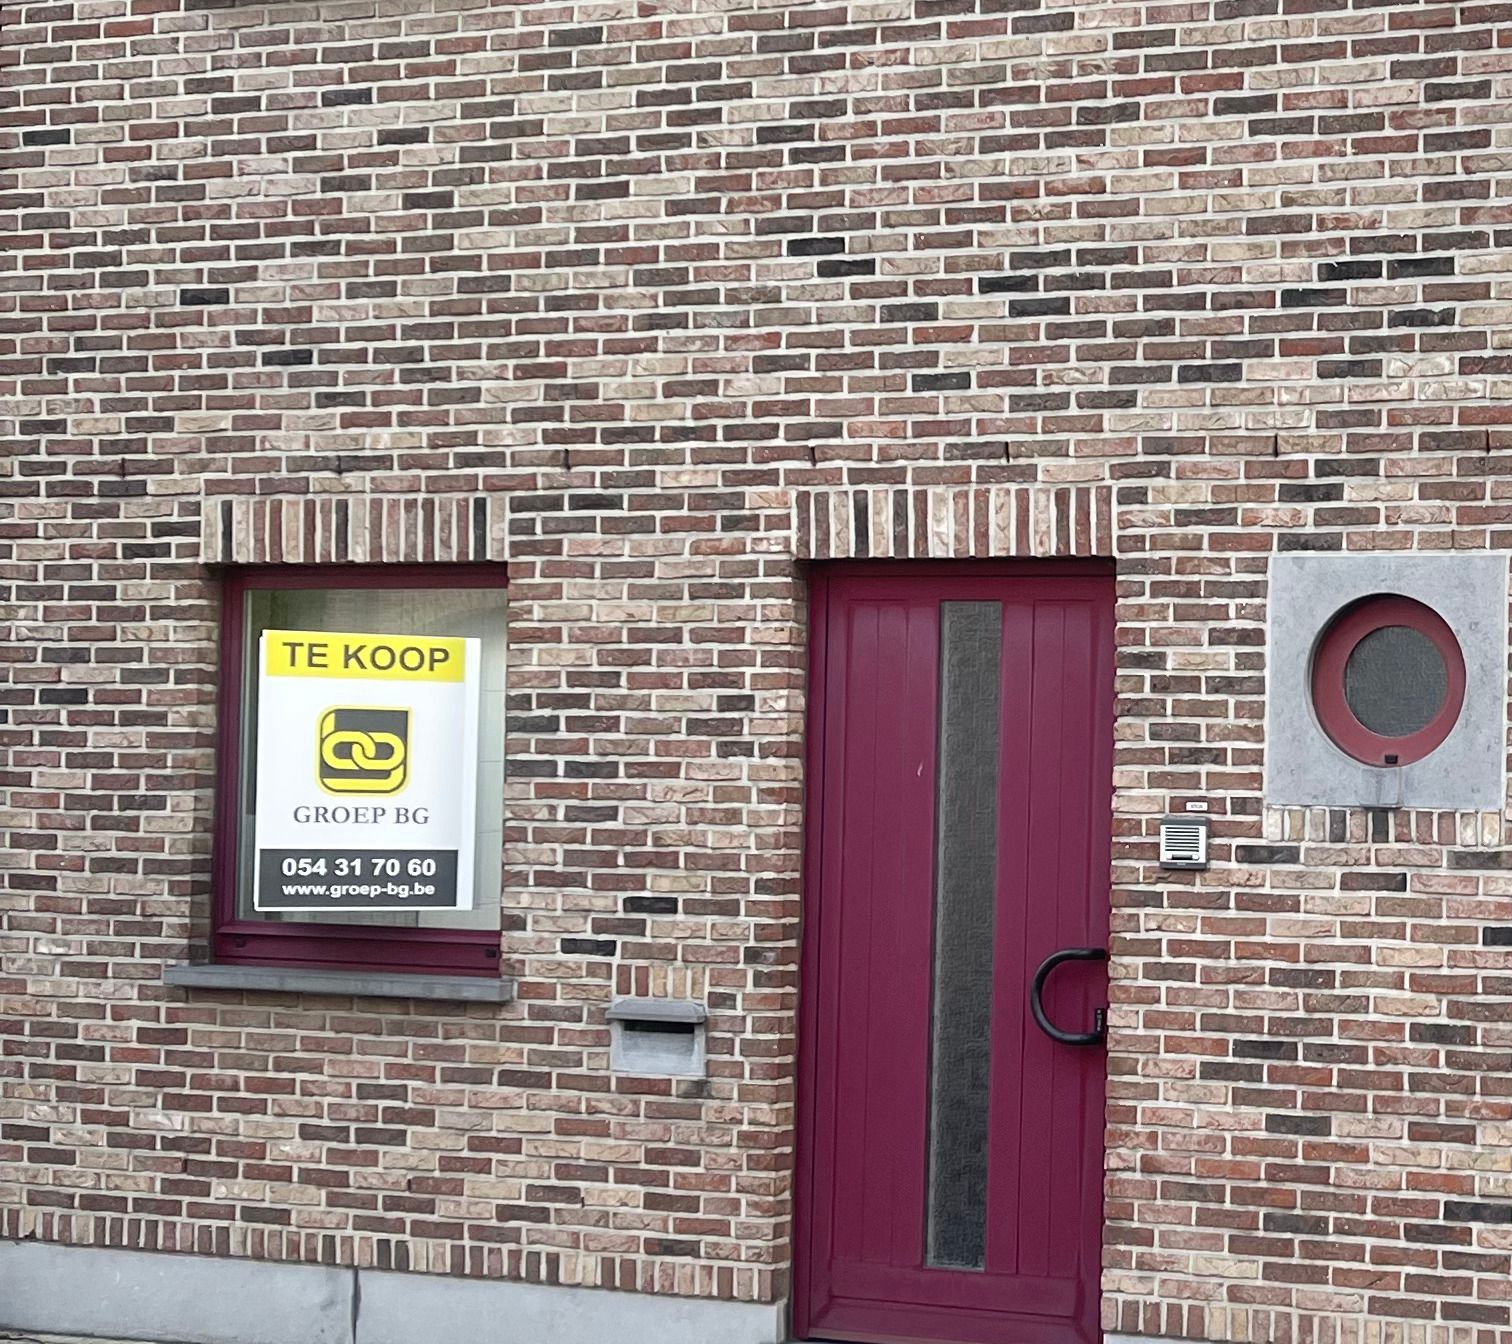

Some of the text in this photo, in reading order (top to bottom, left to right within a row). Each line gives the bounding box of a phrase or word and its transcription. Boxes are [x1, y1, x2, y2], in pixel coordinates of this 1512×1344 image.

[282, 642, 450, 671] TE KOOP
[293, 806, 430, 824] GROEP BG
[281, 858, 436, 876] 054 31 70 60
[281, 882, 435, 898] www.groep-bg.be
